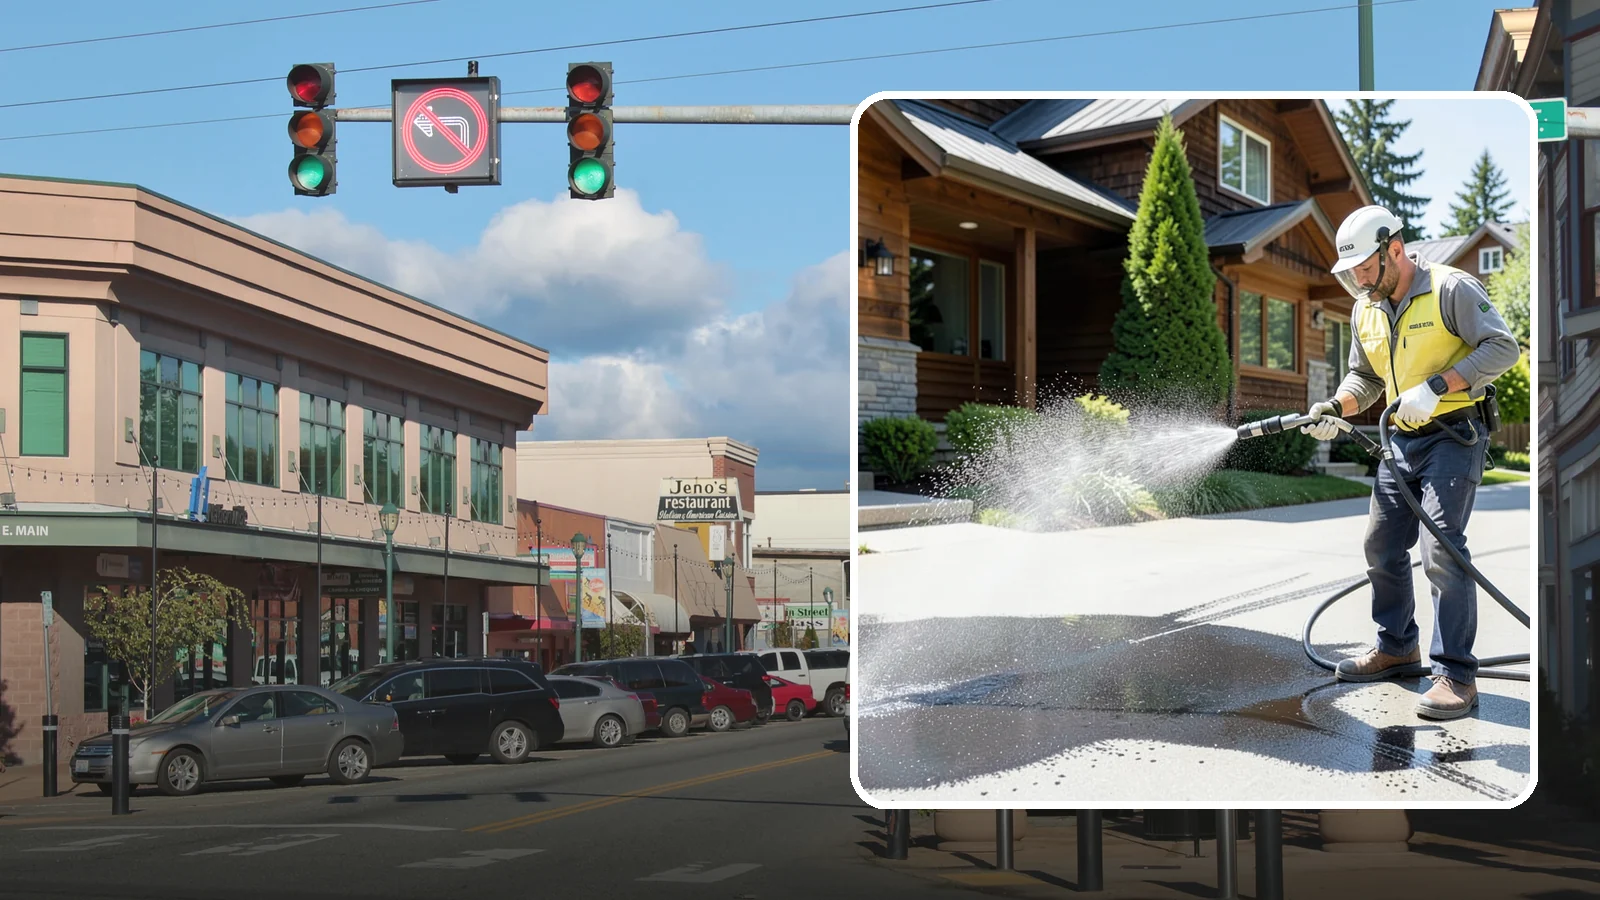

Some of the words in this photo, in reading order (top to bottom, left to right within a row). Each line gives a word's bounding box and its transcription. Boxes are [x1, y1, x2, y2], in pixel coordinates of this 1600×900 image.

[670, 480, 728, 495] Jeno's
[665, 496, 731, 509] restaurant
[658, 509, 681, 520] Italian
[686, 509, 715, 520] American
[715, 509, 738, 519] Cuisine
[2, 525, 13, 536] E.
[15, 525, 49, 536] MAIN
[797, 607, 829, 617] Street
